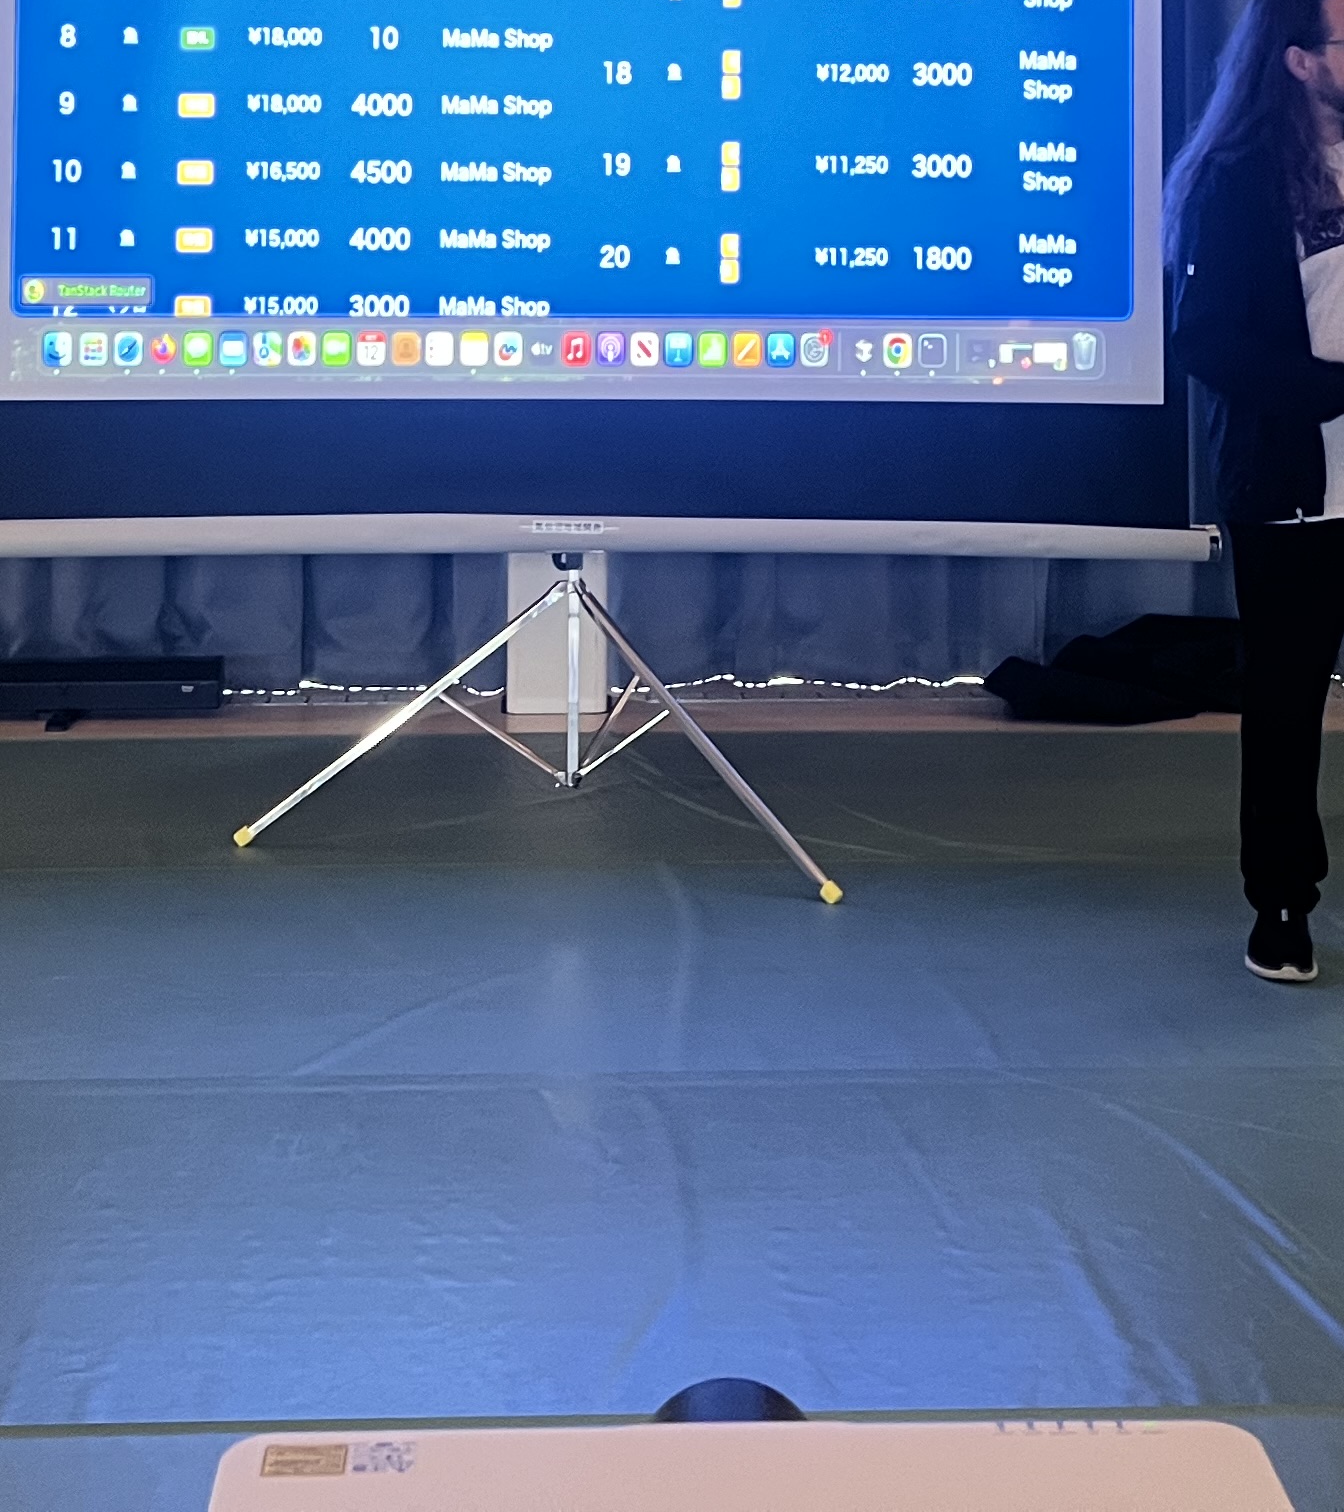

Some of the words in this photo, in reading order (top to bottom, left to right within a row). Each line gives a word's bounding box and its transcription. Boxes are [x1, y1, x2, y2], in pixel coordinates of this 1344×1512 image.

[59, 23, 77, 49] 8
[247, 26, 323, 48] ¥18,000
[369, 25, 400, 51] 10
[442, 27, 500, 49] MaMa
[504, 27, 554, 53] Shop
[1019, 49, 1077, 71] MaMa
[603, 60, 633, 85] 18
[816, 63, 890, 85] ¥12,000
[912, 61, 973, 87] 3000
[1023, 78, 1073, 104] Shop
[59, 90, 76, 115] 9
[247, 93, 323, 115] ¥18,000
[350, 92, 413, 117] 4000
[441, 94, 499, 115] MaMa
[503, 94, 553, 119] Shop
[1018, 141, 1077, 163] MaMa
[52, 158, 82, 183] 10
[246, 160, 321, 183] ¥16,500
[350, 159, 413, 185] 4500
[440, 161, 499, 183] MaMa
[502, 161, 553, 186] Shop
[602, 152, 631, 177] 19
[815, 155, 889, 176] ¥11,250
[911, 153, 973, 179] 3000
[1022, 170, 1073, 196] Shop
[51, 226, 77, 251] 11
[245, 228, 320, 250] ¥15,000
[348, 226, 412, 252] 4000
[439, 228, 498, 249] MaMa
[501, 228, 552, 253] Shop
[1018, 233, 1077, 255] MaMa
[599, 244, 631, 269] 20
[814, 247, 889, 268] ¥11,250
[913, 245, 973, 271] 1800
[1022, 262, 1073, 288] Shop
[109, 284, 147, 297] Router
[243, 295, 319, 316] ¥15,000
[348, 294, 411, 316] 3000
[438, 295, 500, 318] MaMa
[500, 295, 551, 316] Shop
[364, 344, 378, 361] 12
